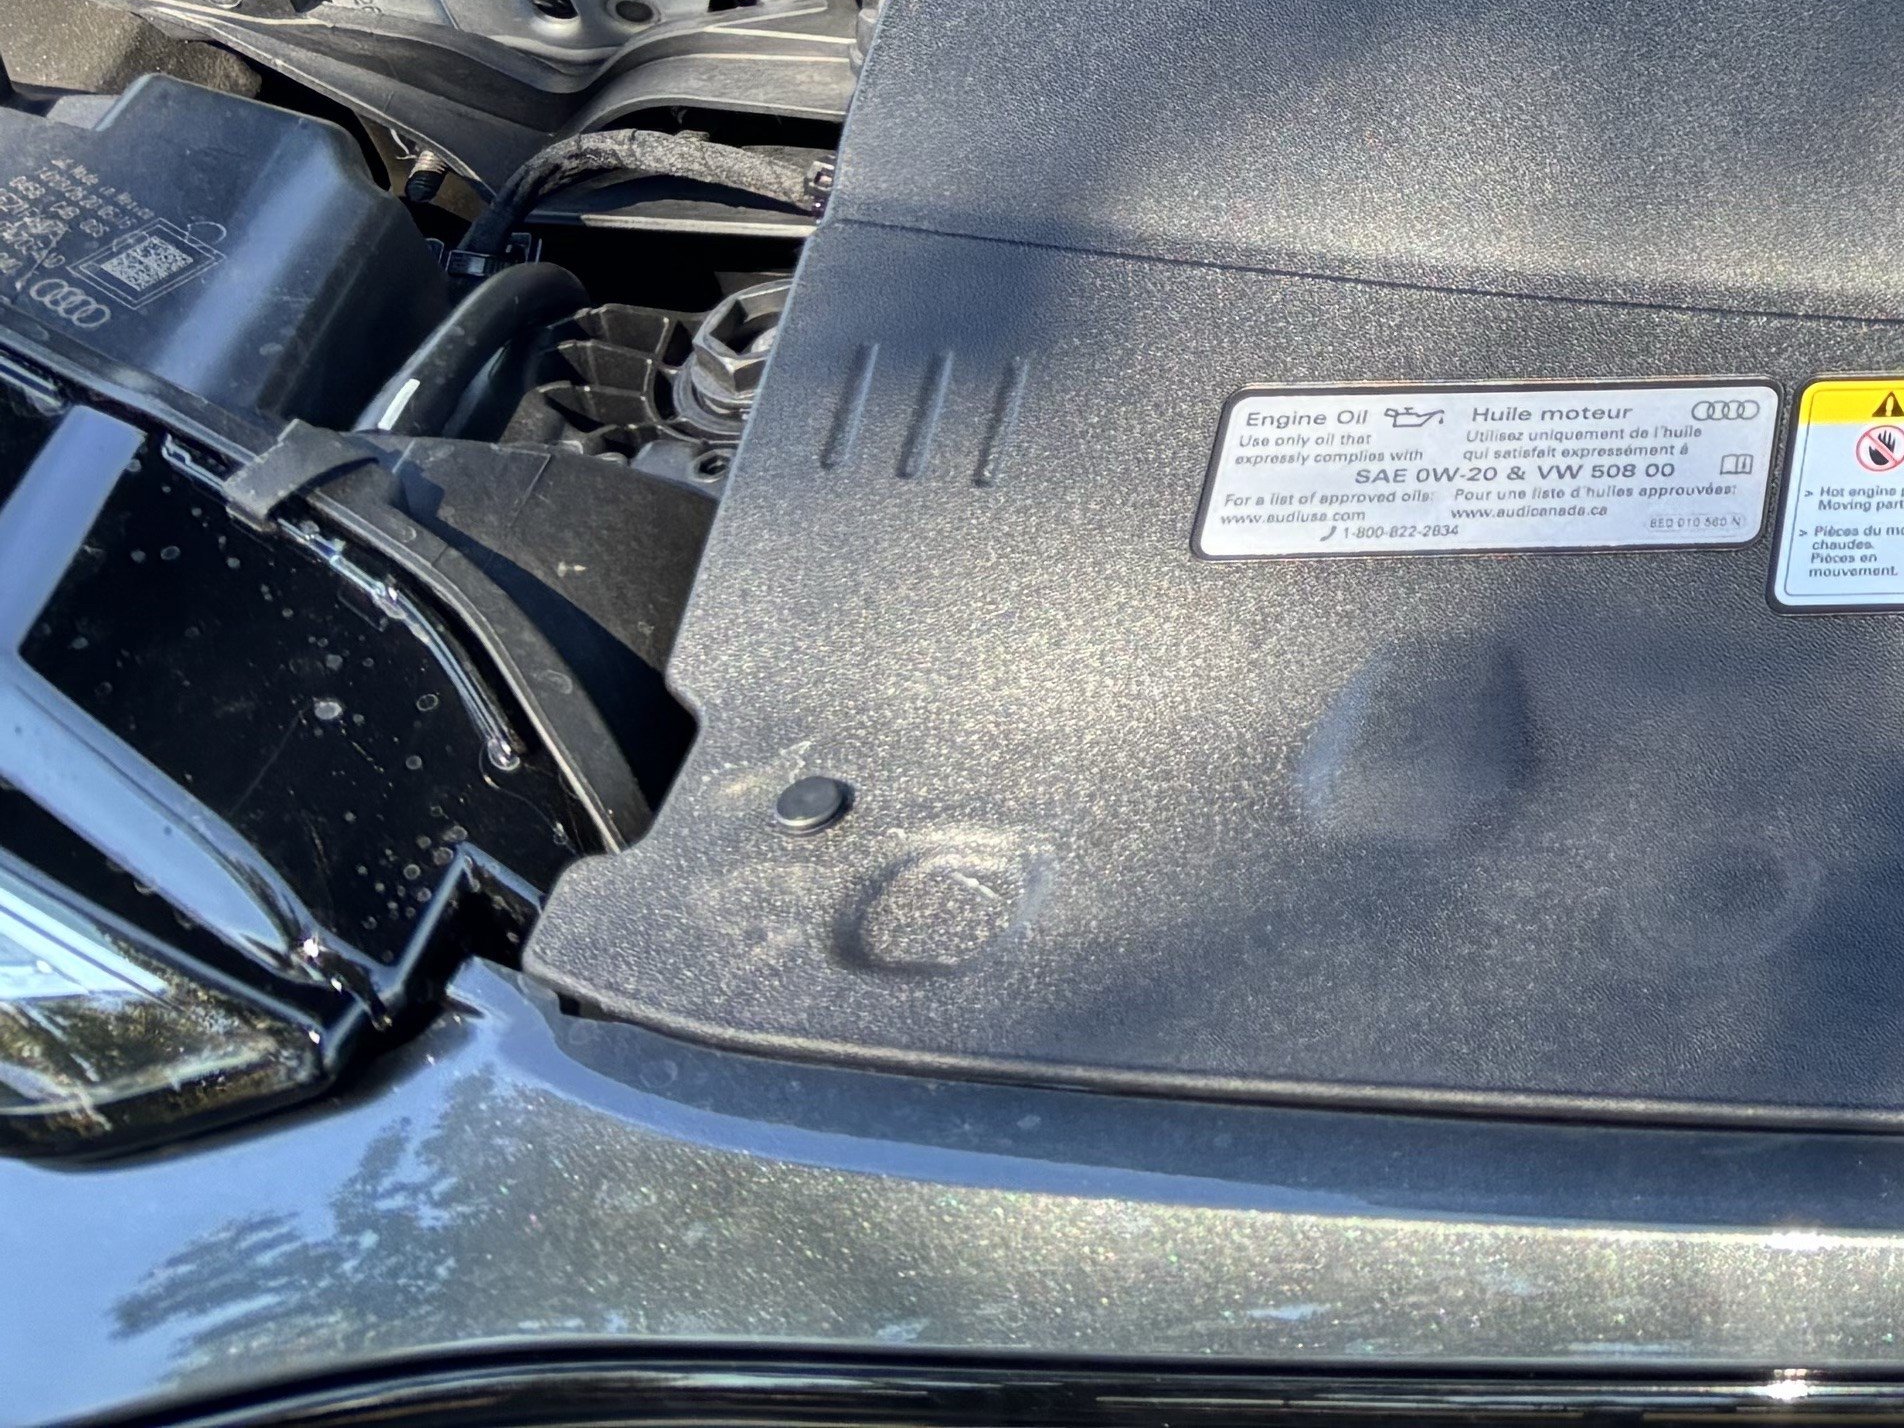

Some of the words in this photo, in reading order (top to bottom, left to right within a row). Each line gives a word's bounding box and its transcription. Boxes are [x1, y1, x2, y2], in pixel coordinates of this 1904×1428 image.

[1246, 412, 1327, 429] Engine
[1337, 409, 1368, 425] Oil
[1471, 407, 1532, 423] Huile
[1540, 407, 1633, 422] moteur
[1239, 434, 1270, 448] Use
[1275, 436, 1310, 449] only
[1315, 434, 1335, 446] oil
[1340, 433, 1371, 445] that
[1466, 428, 1524, 443] Utilisez
[1528, 428, 1624, 442] uniquement
[1629, 427, 1648, 439] de
[1235, 452, 1310, 466] expressly
[1314, 452, 1384, 465] complies
[1391, 449, 1423, 461] with
[1463, 447, 1490, 462] qui
[1494, 445, 1556, 460] satisfait
[1561, 443, 1675, 459] expressément
[1355, 468, 1407, 484] SAE
[1416, 467, 1498, 483] 0W-20
[1506, 468, 1526, 482] &
[1537, 464, 1584, 479] VW
[1591, 463, 1636, 478] 508
[1646, 462, 1676, 478] 00
[1224, 494, 1251, 507] For
[1256, 498, 1264, 506] a
[1270, 493, 1295, 506] list
[1300, 491, 1317, 505] of
[1320, 491, 1396, 507] approved
[1454, 488, 1491, 501] Pour
[1497, 488, 1527, 500] une
[1532, 486, 1565, 499] liste
[1819, 486, 1845, 498] Hot
[1848, 487, 1897, 501] engine
[1450, 505, 1608, 520] www.audicanada.ca
[1818, 499, 1871, 514] Moving
[1220, 510, 1366, 525] www.audiusa.com
[1344, 524, 1459, 539] 1-800-822-2834
[1814, 525, 1859, 538] Pièces
[1863, 525, 1882, 537] du
[1812, 540, 1875, 551] chaudes.
[1810, 553, 1855, 565] Pièces
[1860, 554, 1877, 564] en
[1809, 566, 1899, 578] mouvement.
